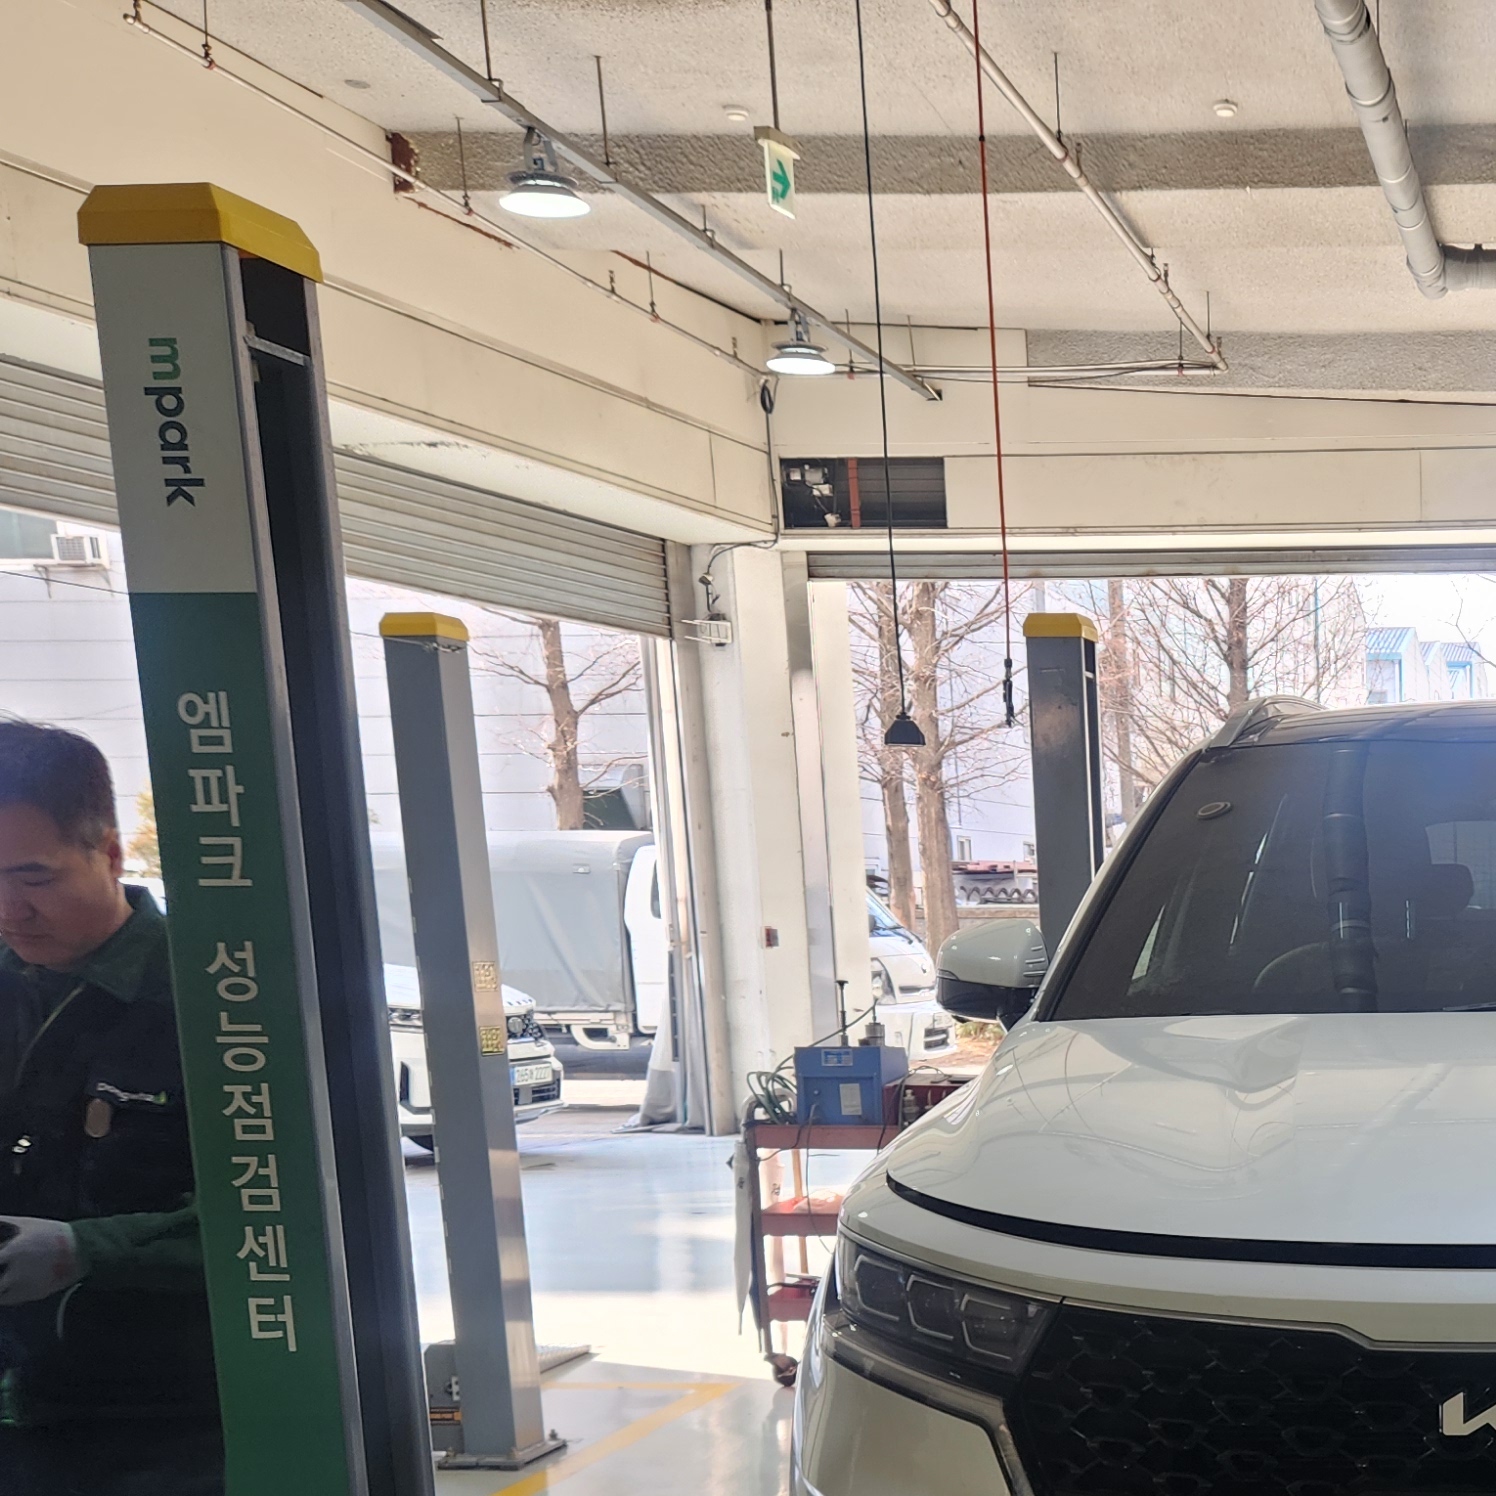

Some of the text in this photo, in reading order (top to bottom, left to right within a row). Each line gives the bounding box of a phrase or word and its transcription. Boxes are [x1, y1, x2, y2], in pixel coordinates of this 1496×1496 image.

[143, 336, 206, 508] mpark
[177, 690, 253, 889] 엠파크
[205, 940, 297, 1353] 성능점검센터
